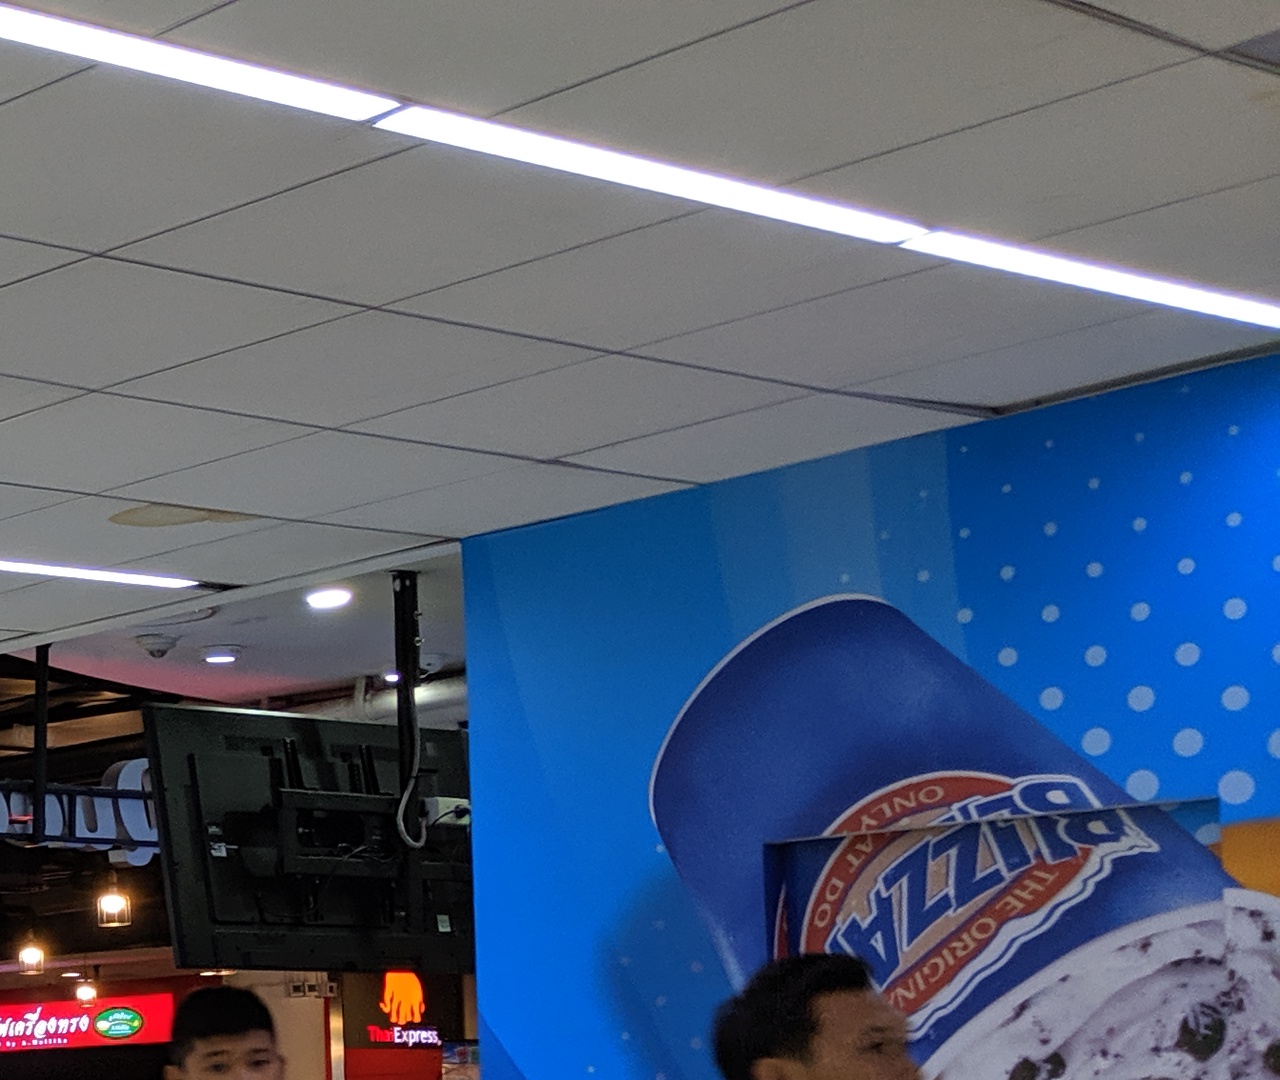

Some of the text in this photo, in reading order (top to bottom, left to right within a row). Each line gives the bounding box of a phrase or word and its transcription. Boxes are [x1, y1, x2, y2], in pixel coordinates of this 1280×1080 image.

[857, 785, 945, 833] ONLY
[844, 834, 874, 872] AT
[830, 779, 1129, 986] BLIZZA
[995, 868, 1059, 916] THE
